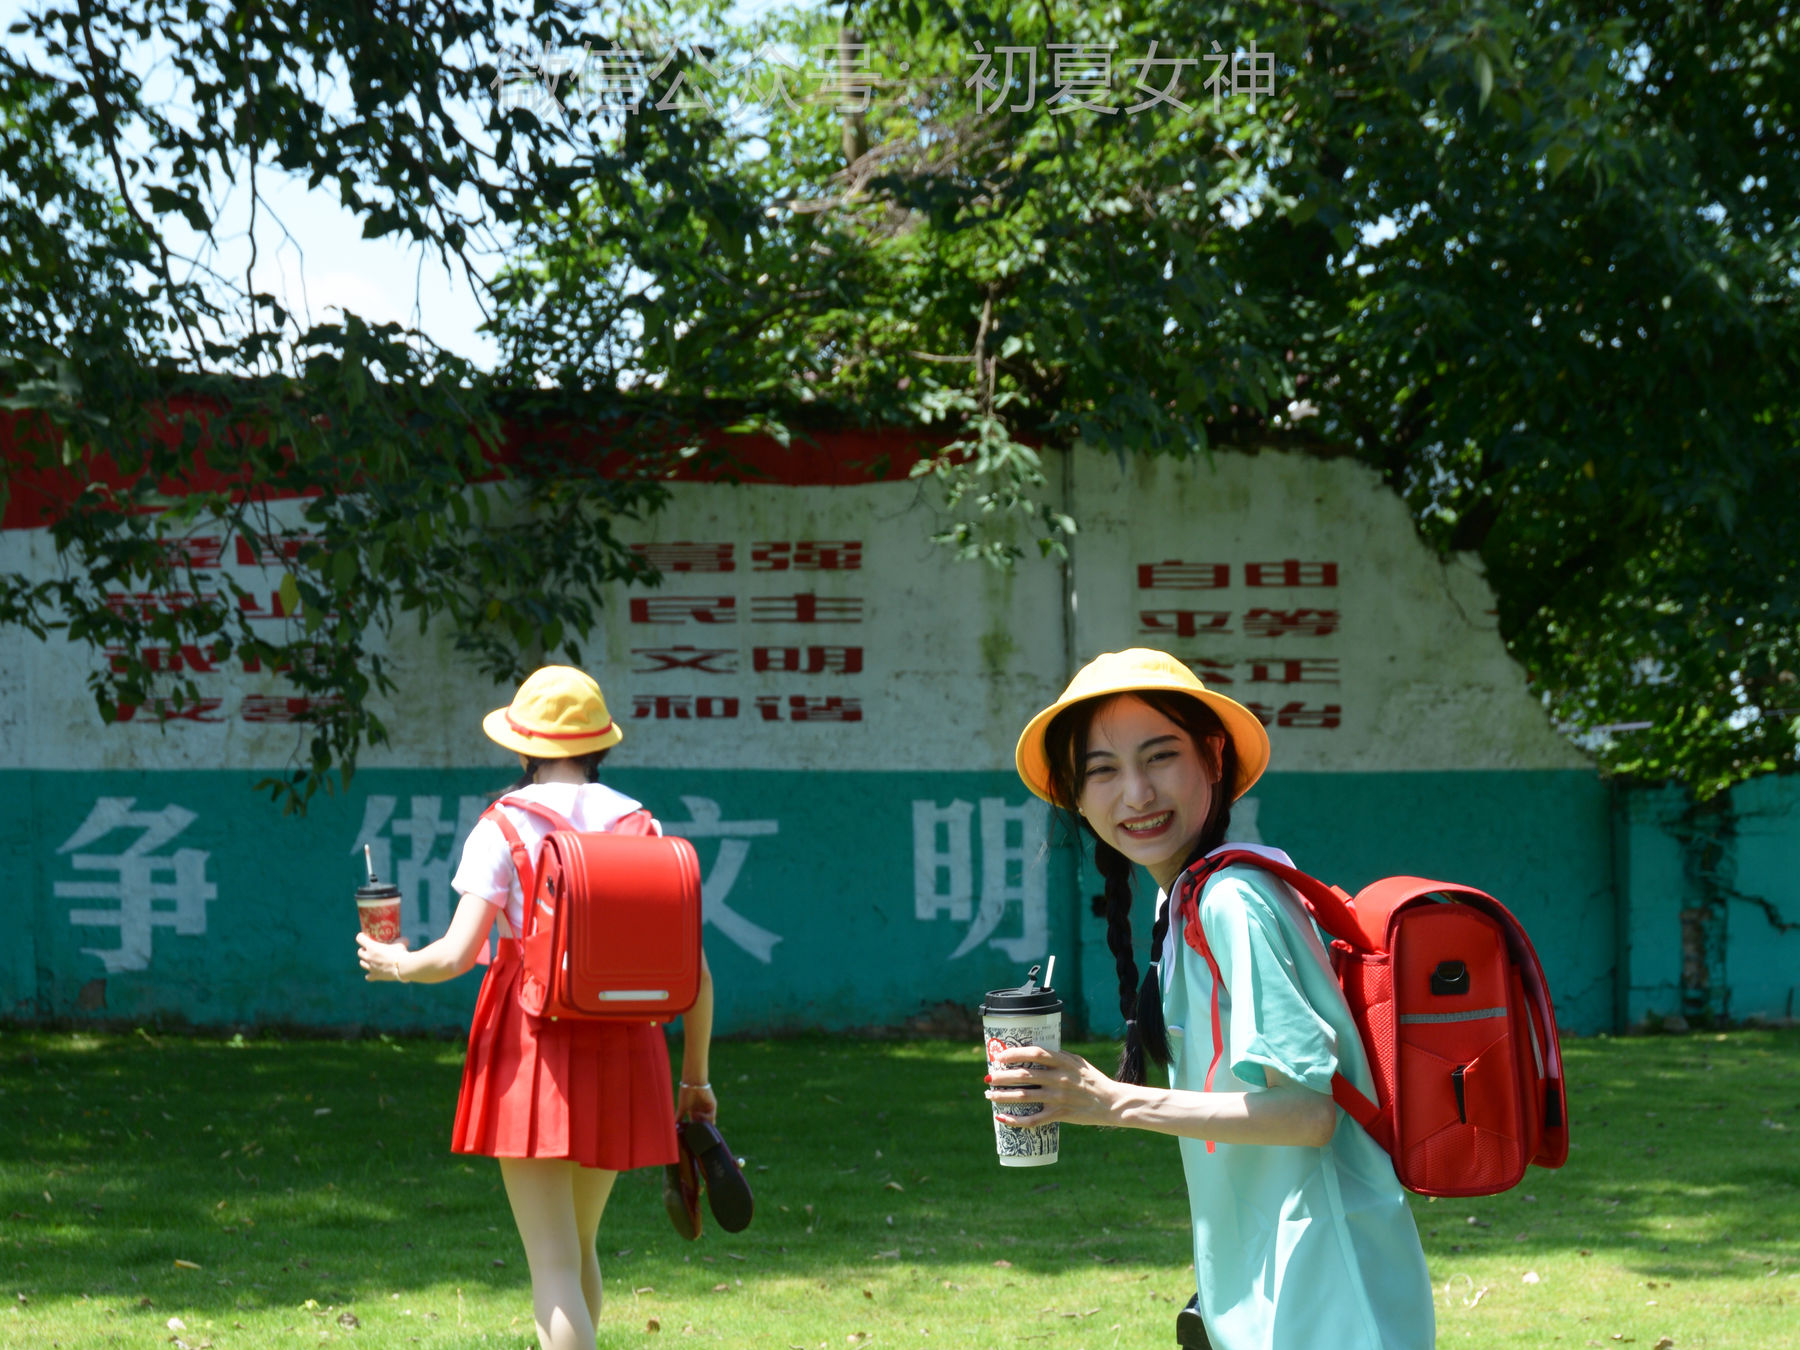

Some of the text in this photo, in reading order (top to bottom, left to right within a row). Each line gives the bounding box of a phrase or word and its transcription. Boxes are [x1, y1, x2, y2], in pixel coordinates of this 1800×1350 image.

[629, 540, 863, 572] 富强
[1138, 559, 1338, 589] 自由
[630, 593, 863, 623] 民主
[1138, 608, 1341, 638] 平等
[630, 645, 863, 674] 文明
[630, 694, 863, 722] 和谐
